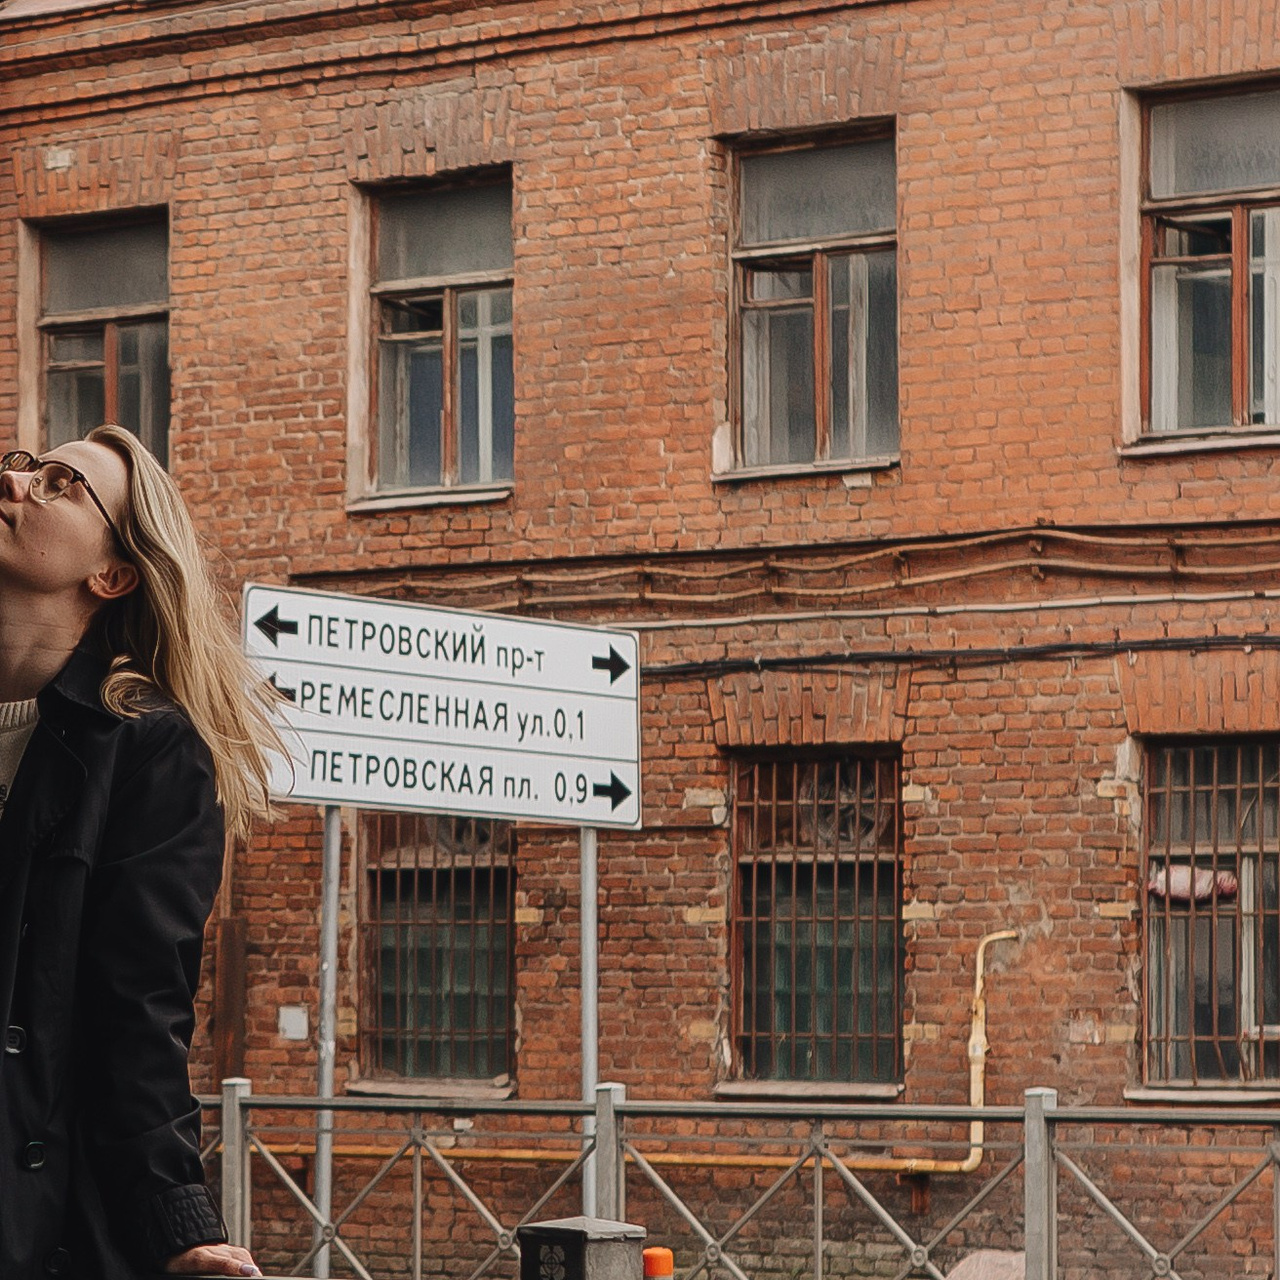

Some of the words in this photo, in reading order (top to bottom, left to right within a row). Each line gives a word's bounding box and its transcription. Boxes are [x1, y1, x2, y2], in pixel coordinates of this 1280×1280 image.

[307, 613, 486, 666] ПЕТРОВСКИЙ
[496, 645, 545, 677] пр-т
[301, 681, 509, 733] РЕМЕСЛЕННАЯ
[310, 749, 493, 797] ПЕТРОВСКАЯ
[503, 778, 539, 800] пл.
[554, 772, 588, 805] 0,9
